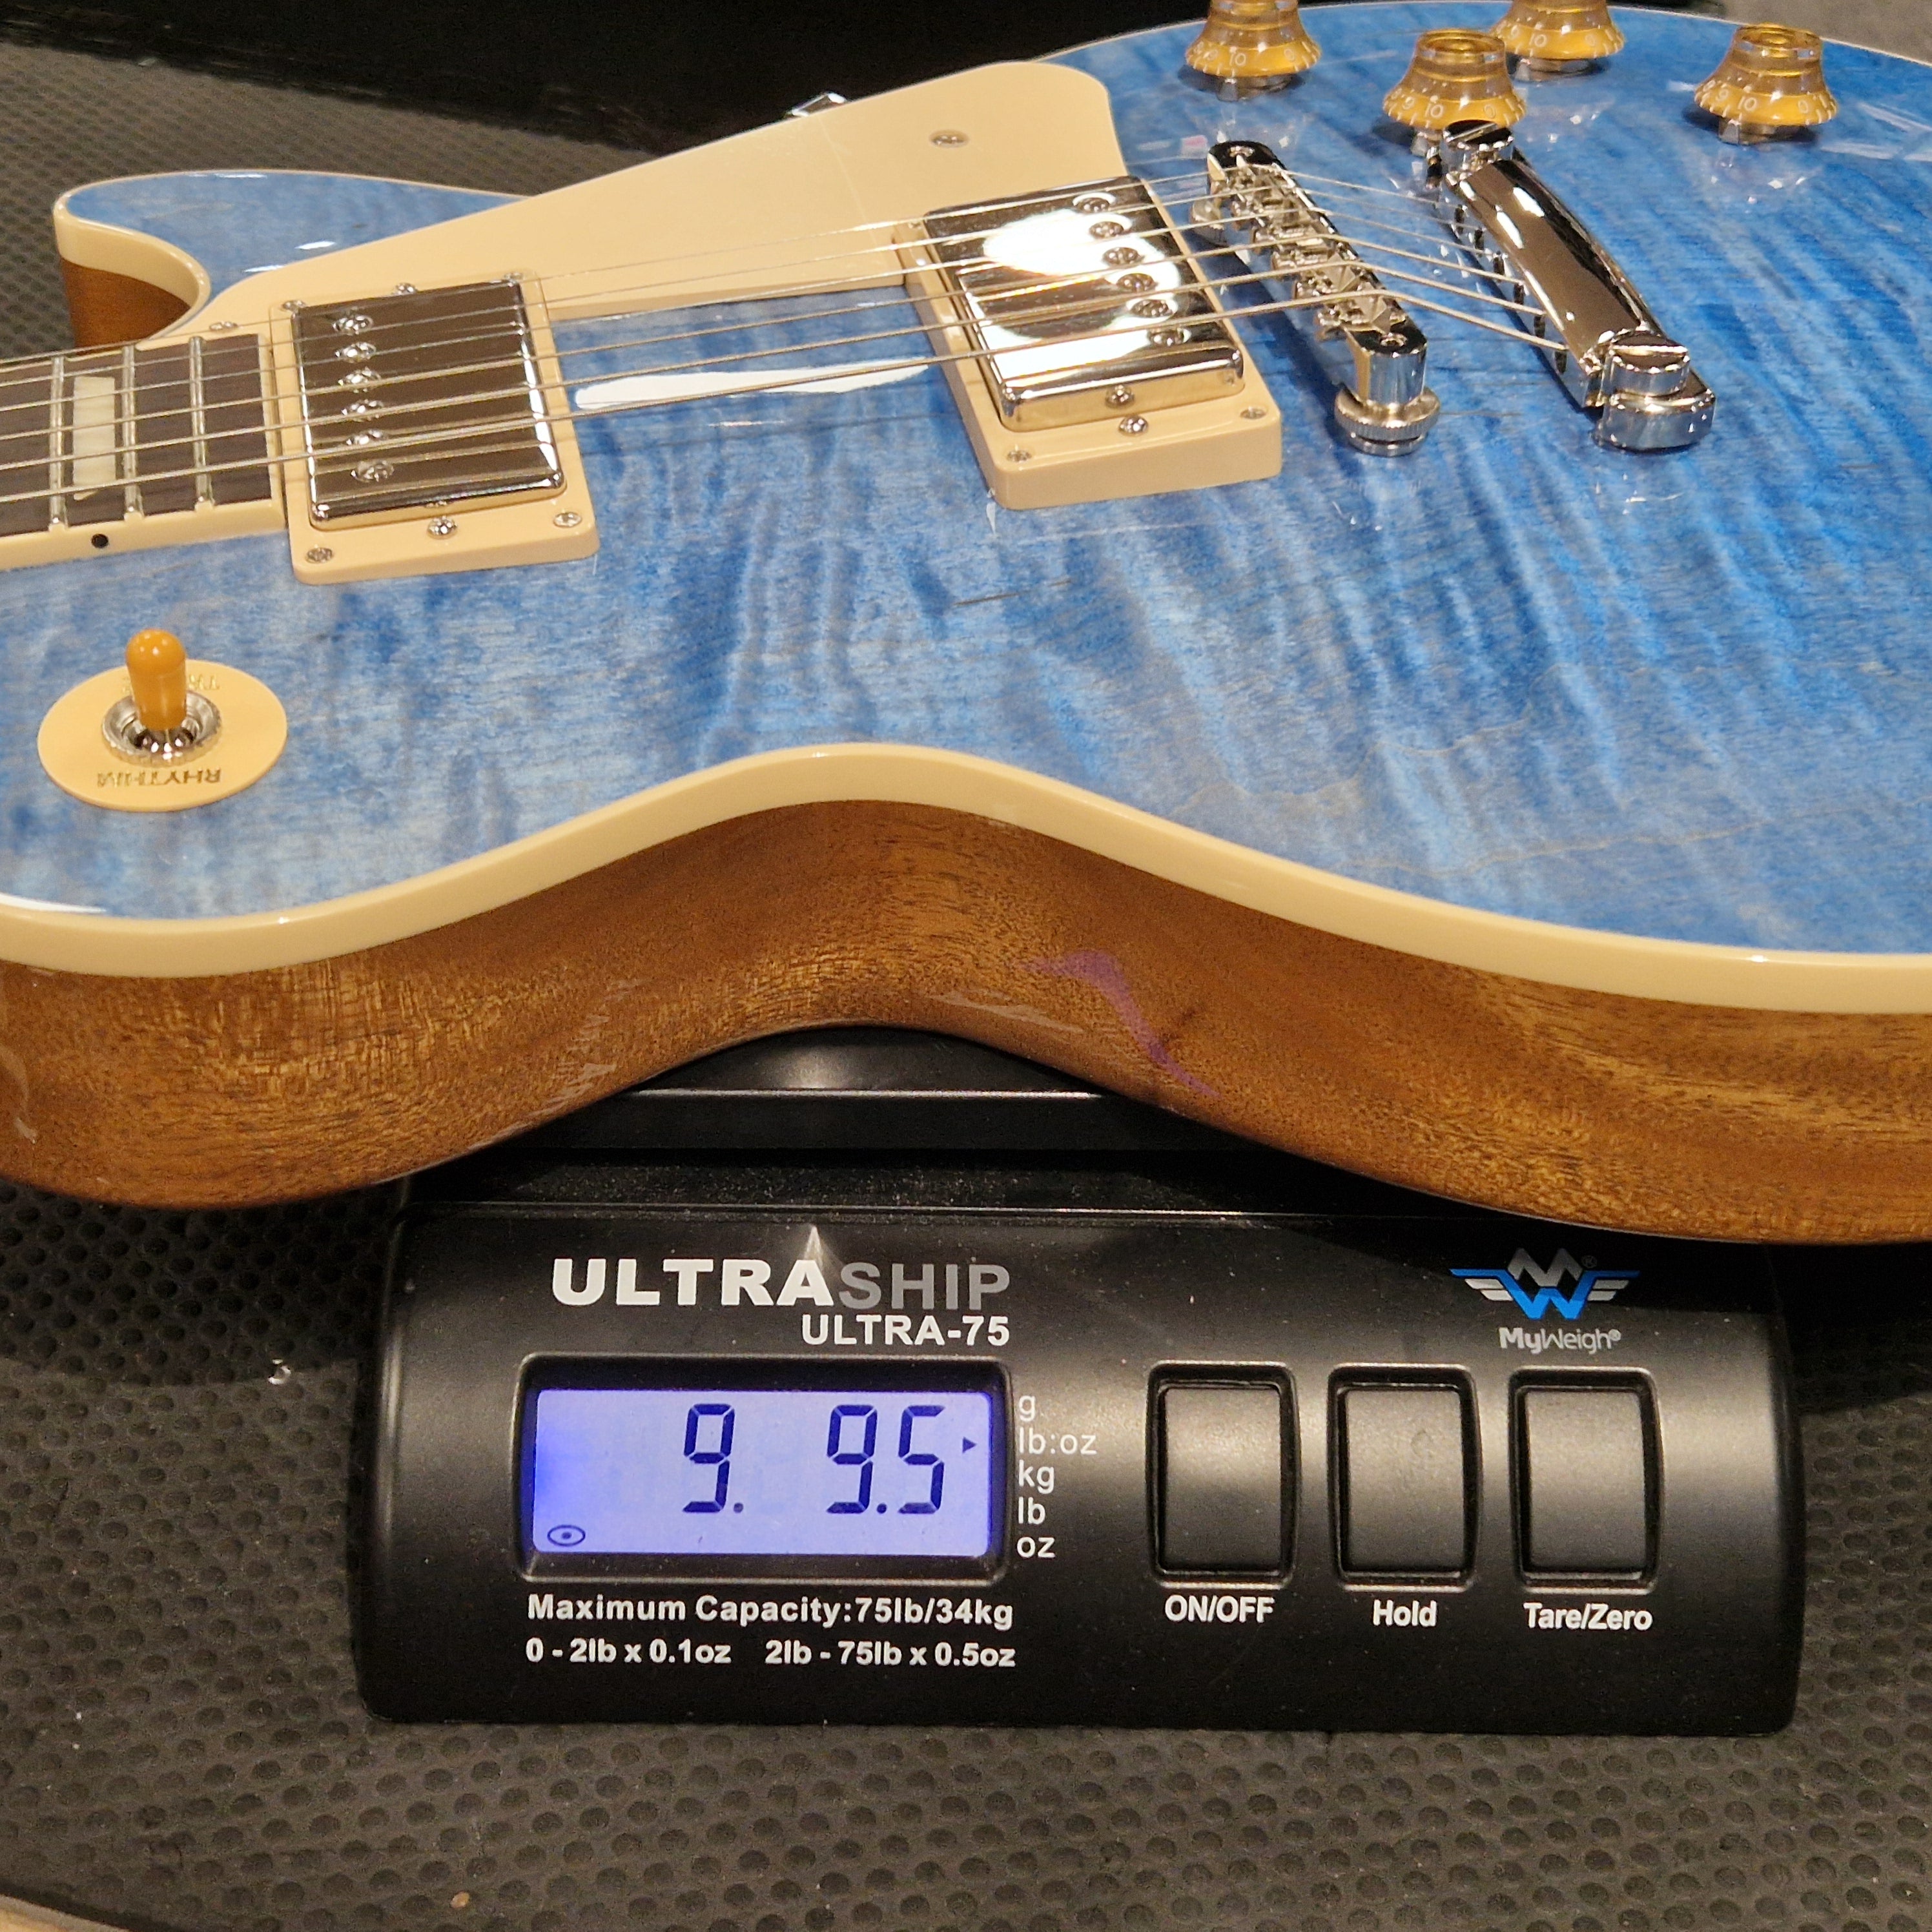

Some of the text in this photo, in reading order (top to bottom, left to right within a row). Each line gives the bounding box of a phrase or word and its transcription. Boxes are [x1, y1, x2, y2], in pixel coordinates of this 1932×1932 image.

[1424, 103, 1444, 119] 10
[1738, 96, 1758, 112] 10
[98, 767, 221, 787] RHYTHM
[552, 1259, 1010, 1311] ULTRASHIP
[802, 1315, 1010, 1346] ULTRA-75
[1018, 1395, 1036, 1423] g
[1018, 1428, 1097, 1454] lb:oz
[827, 1404, 945, 1515] 9.5
[1018, 1463, 1055, 1494] kg
[1018, 1497, 1046, 1525] lb
[1017, 1537, 1055, 1558] oz
[528, 1594, 686, 1621] Maximum
[1165, 1594, 1275, 1623] ON/OFF
[1373, 1599, 1437, 1627] Hold
[1523, 1602, 1653, 1630] Tare/Zero
[526, 1638, 543, 1663] 0
[570, 1638, 617, 1663] 2lb
[624, 1643, 642, 1663] x
[649, 1638, 731, 1664] 0.1oz
[765, 1639, 812, 1665] 2lb
[838, 1640, 902, 1665] 75lb
[910, 1647, 927, 1666] x
[934, 1641, 1016, 1667] 0.5oz
